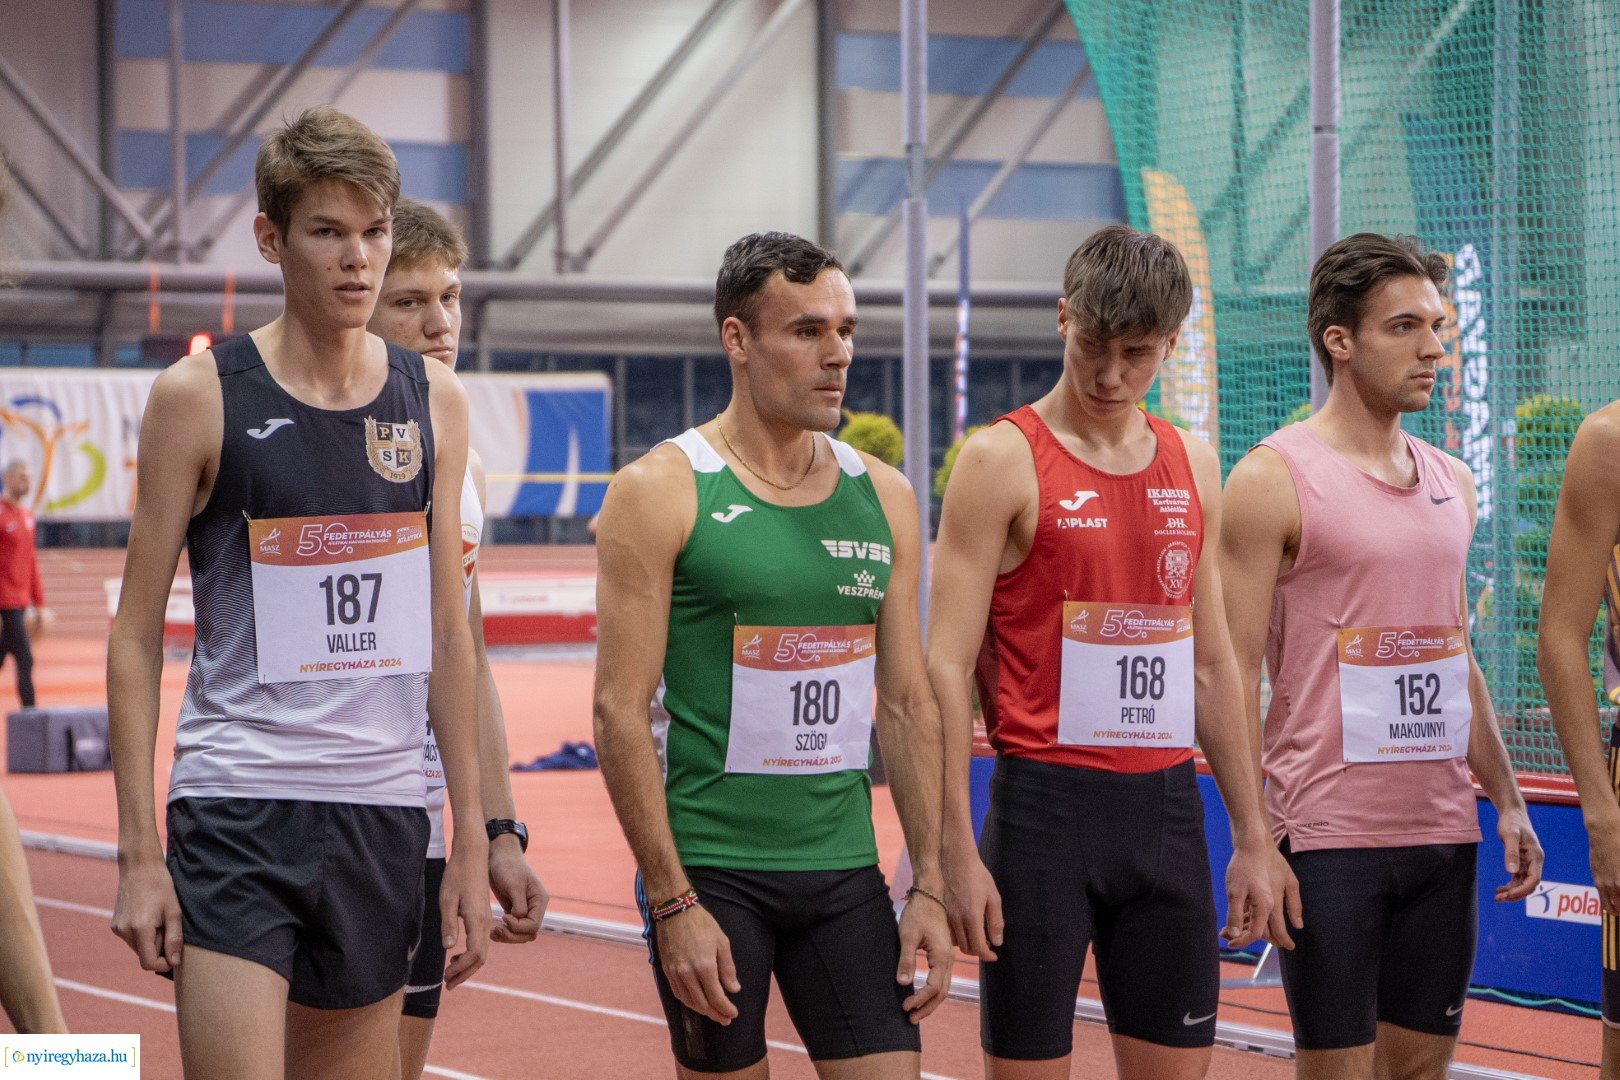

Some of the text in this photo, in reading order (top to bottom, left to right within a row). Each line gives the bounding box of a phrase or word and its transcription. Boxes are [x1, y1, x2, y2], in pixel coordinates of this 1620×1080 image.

[379, 426, 406, 439] P V
[382, 450, 410, 462] S K
[1146, 488, 1190, 499] IKARUS
[323, 528, 392, 541] FEDETTPÁLYÁS
[259, 544, 280, 552] MASZ
[319, 572, 383, 626] 187
[837, 585, 885, 600] VESZPRÉM
[1123, 615, 1175, 627] FEDETTPÁLYÁS
[326, 632, 377, 653] VALLER
[797, 639, 851, 649] FEDETTPÁLYÁS
[1397, 636, 1445, 646] FEDETTPÁLYÁS
[299, 658, 402, 673] NYÍREGYHÁZA 2024
[1116, 655, 1166, 701] 168
[1394, 673, 1442, 716] 152
[790, 679, 840, 726] 180
[1121, 705, 1155, 724] PETRÓ
[1093, 729, 1173, 740] NYÍREGYHÁZA 2024
[1389, 721, 1446, 739] MAKOVINYI
[795, 730, 828, 751] SZÖGI
[1377, 745, 1437, 755] NYÍREGYHÁZA
[762, 756, 829, 767] NYÍREGYHÁZA
[1557, 891, 1601, 918] pola
